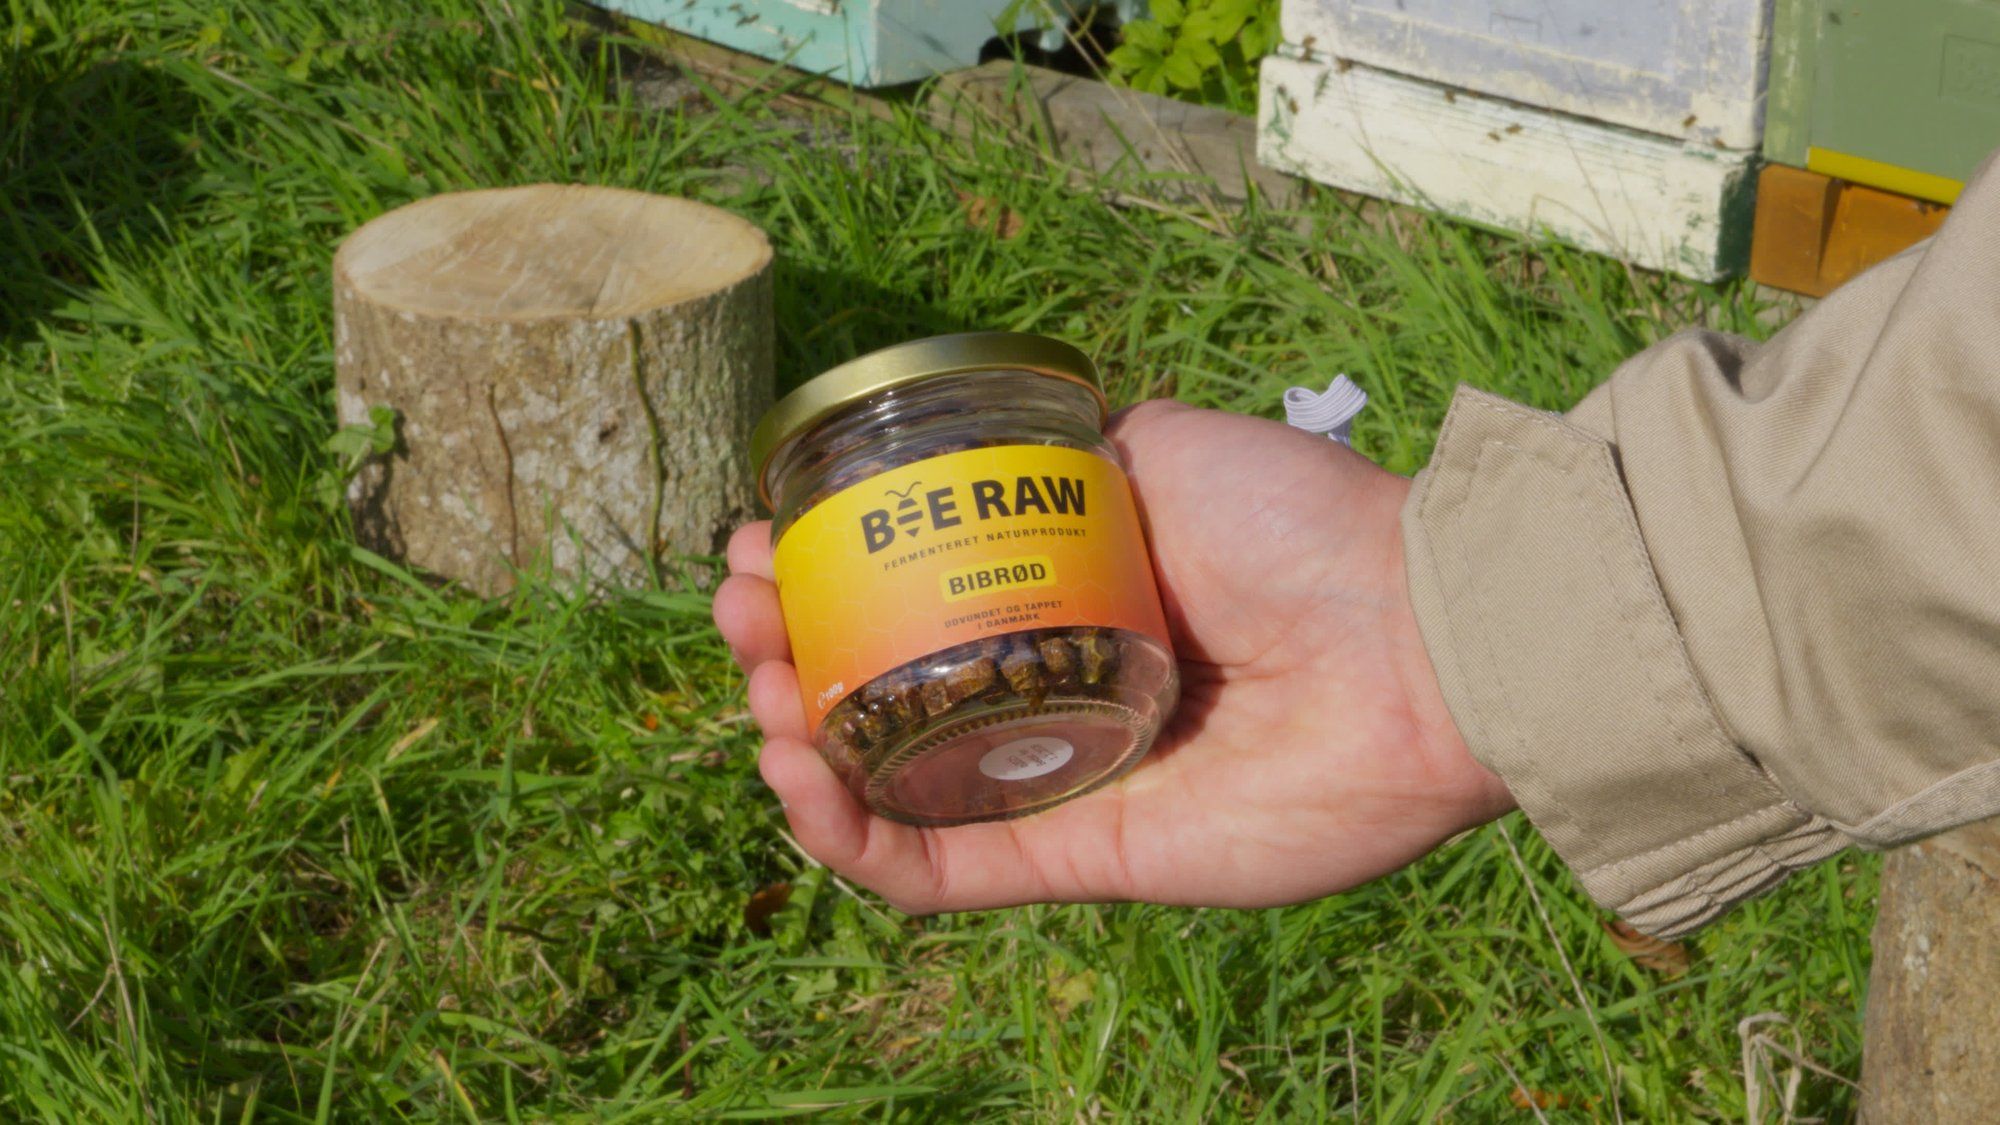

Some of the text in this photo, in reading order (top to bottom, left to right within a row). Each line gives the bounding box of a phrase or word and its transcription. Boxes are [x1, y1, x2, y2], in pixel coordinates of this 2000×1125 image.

[971, 476, 1086, 520] RAW
[884, 528, 1087, 571] FERMENTERET NATURPRODUKT
[948, 563, 1046, 595] BIBRØD
[986, 613, 1040, 628] DANMARK
[1025, 600, 1063, 610] TAPPET
